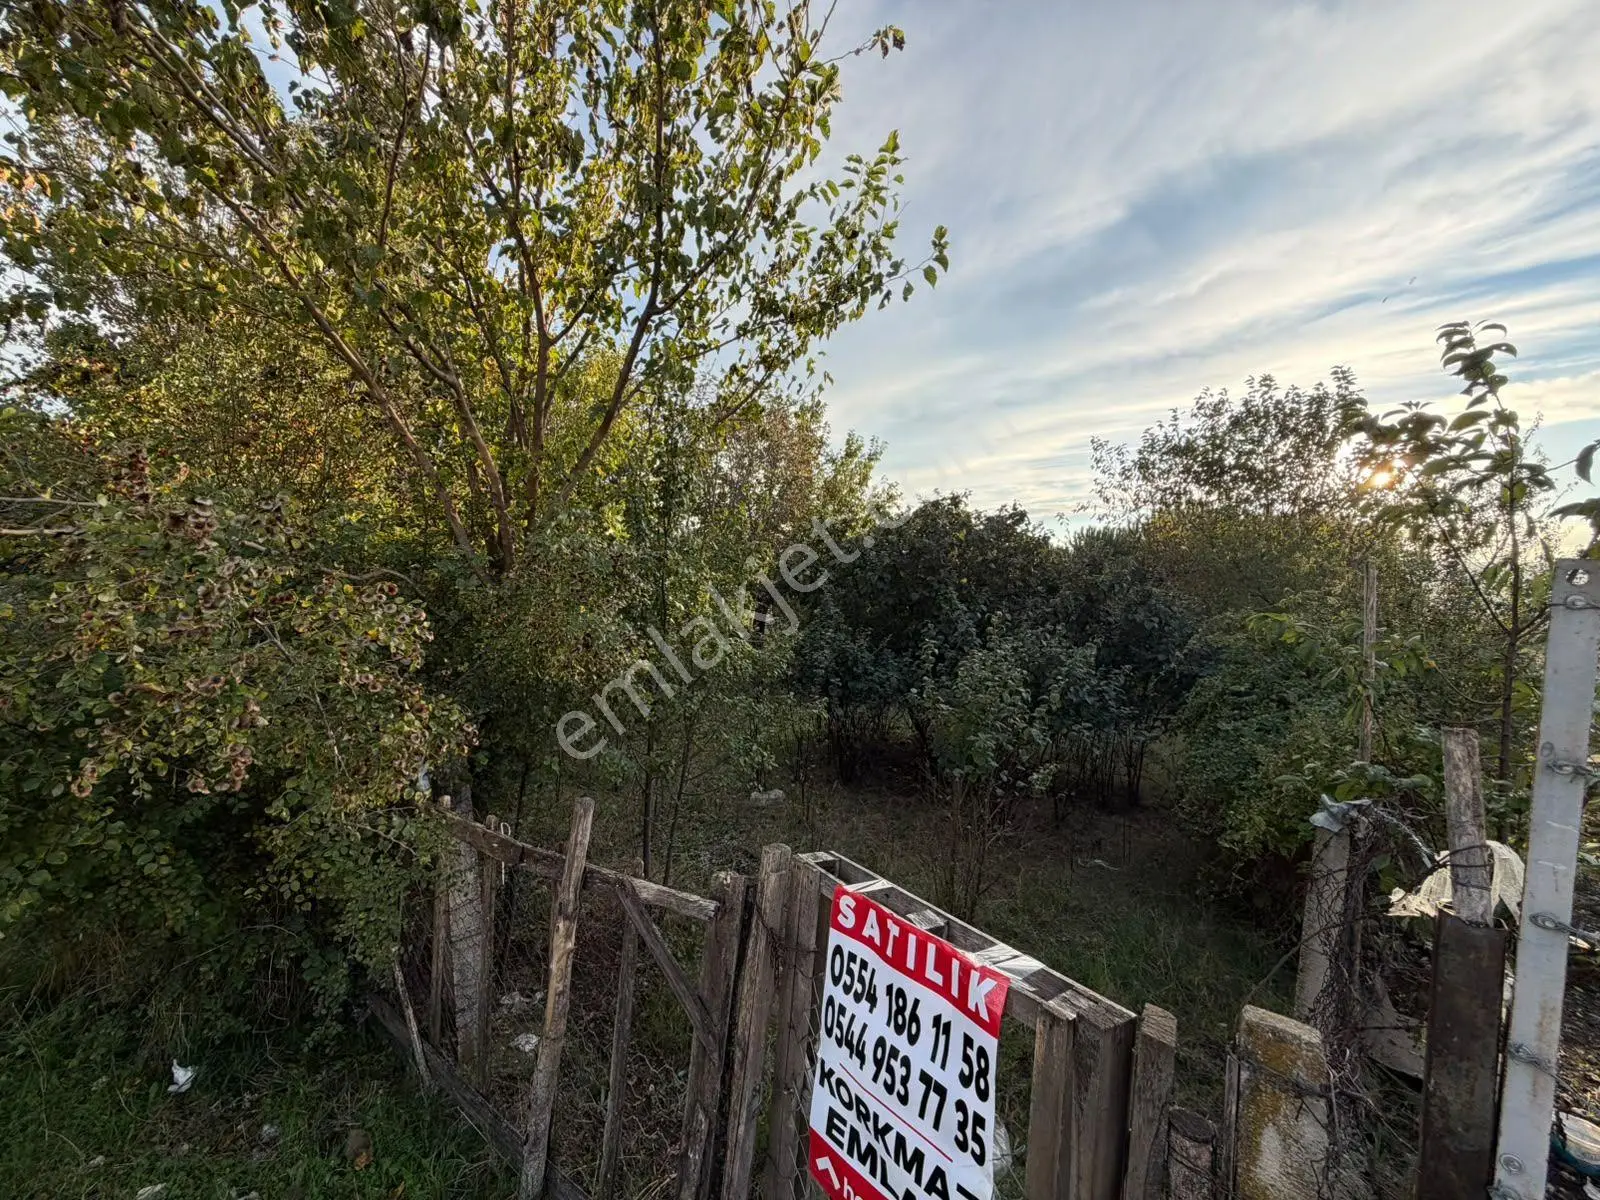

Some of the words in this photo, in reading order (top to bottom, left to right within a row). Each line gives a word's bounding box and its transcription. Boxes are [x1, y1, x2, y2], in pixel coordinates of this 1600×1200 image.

[831, 944, 878, 1014] 0554
[885, 983, 921, 1046] 186
[931, 1013, 952, 1071] 11
[958, 1032, 990, 1103] 58
[837, 895, 998, 1023] SATILIK
[818, 1057, 981, 1200] KORKMA
[824, 995, 868, 1071] 0544
[873, 1035, 912, 1106] 953
[918, 1068, 949, 1132] 77
[954, 1099, 987, 1167] 35
[825, 1106, 918, 1200] EML
